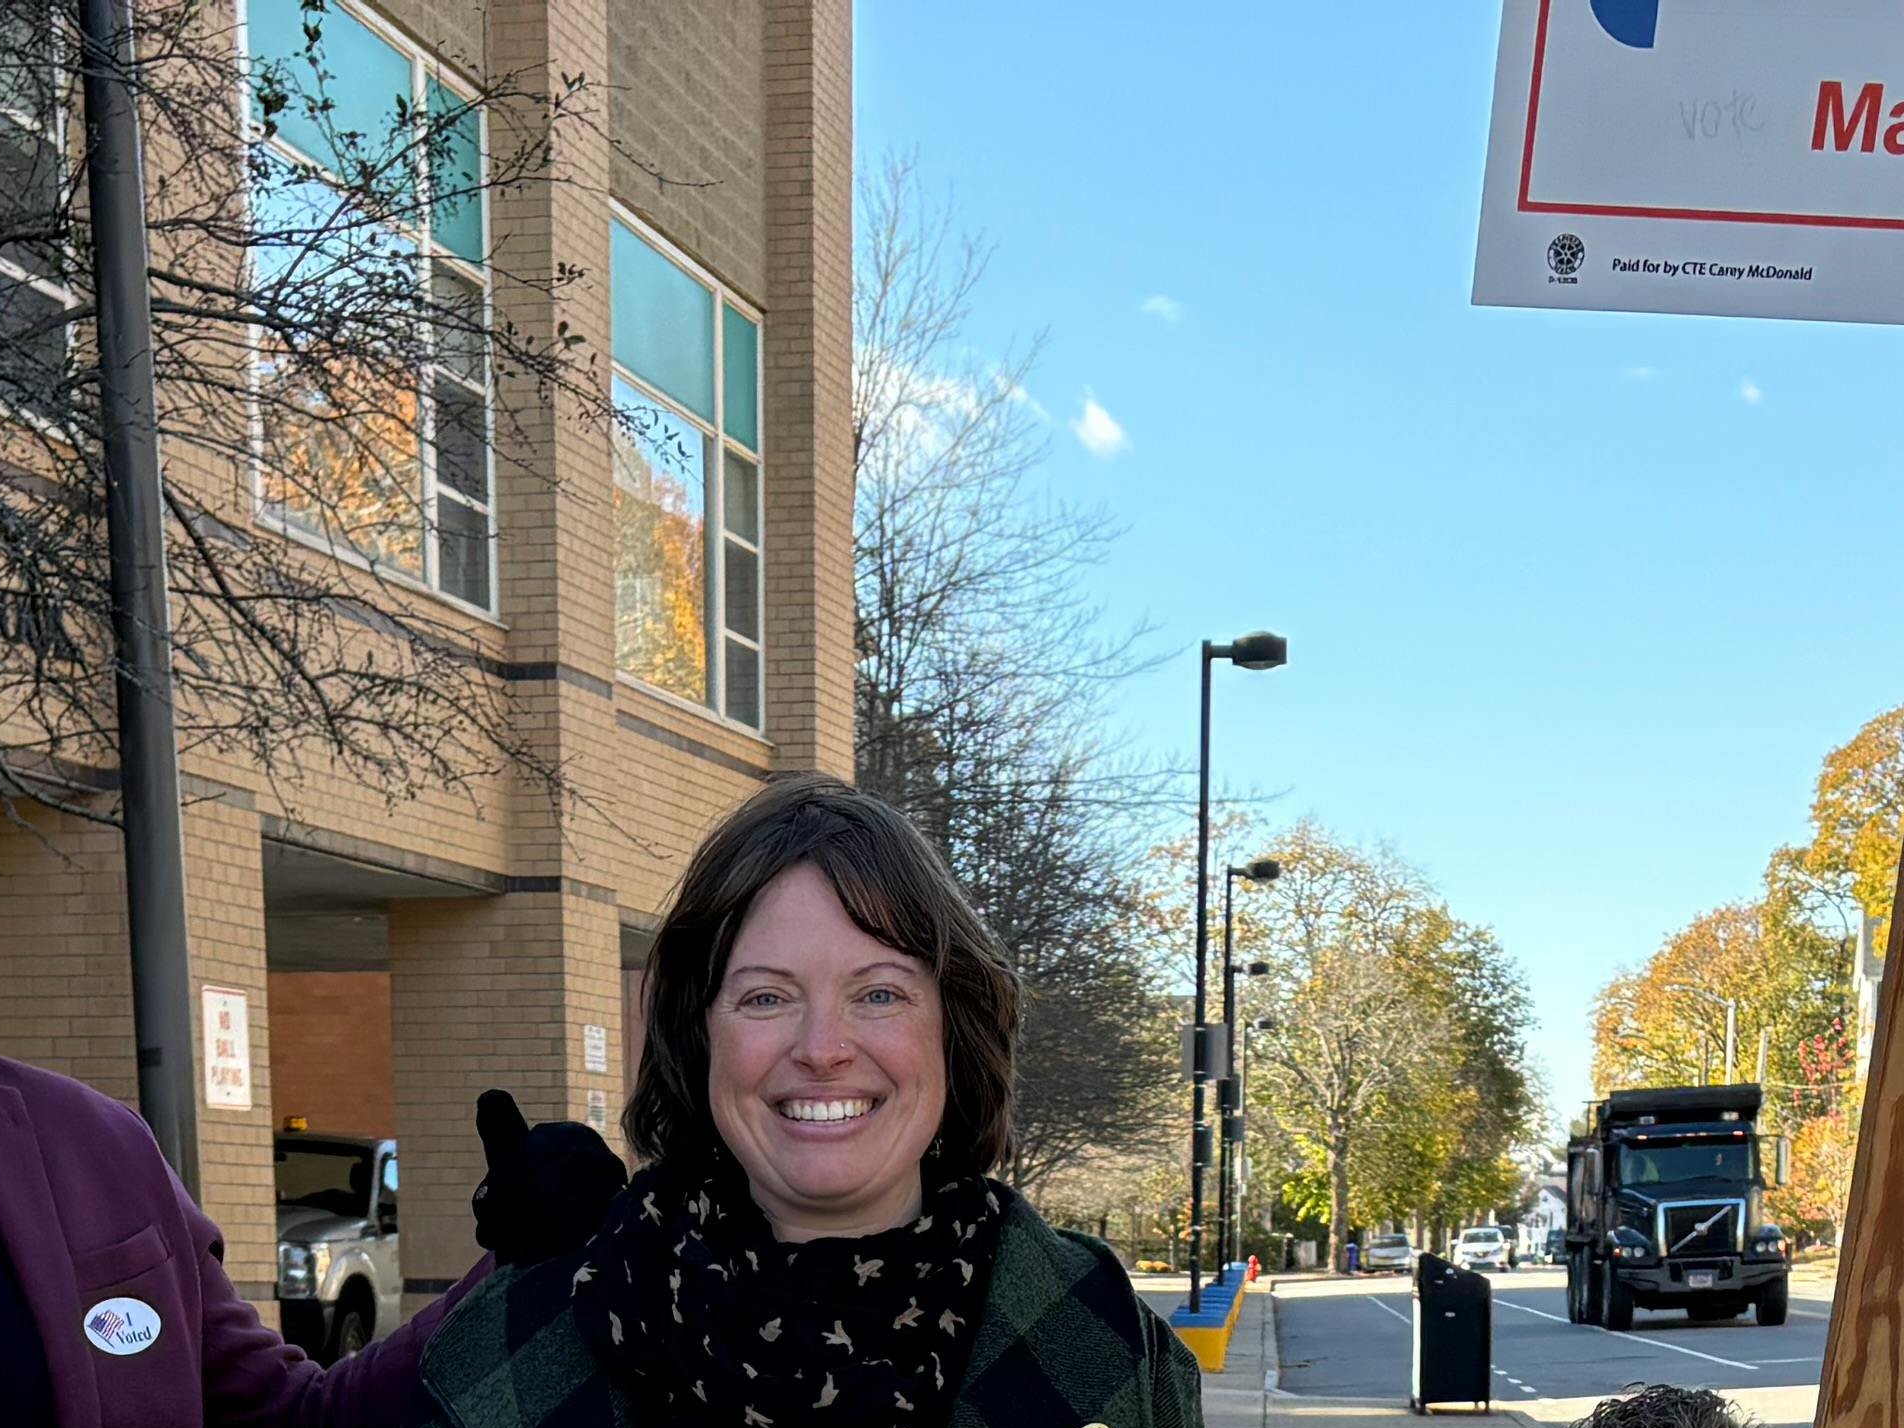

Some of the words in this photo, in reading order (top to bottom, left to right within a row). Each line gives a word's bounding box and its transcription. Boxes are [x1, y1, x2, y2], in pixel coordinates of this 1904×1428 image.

[1612, 258, 1640, 272] Paid
[1642, 259, 1661, 274] for
[1663, 261, 1680, 277] by
[1681, 261, 1707, 276] CTE
[1708, 263, 1746, 281] Carey
[1745, 264, 1813, 281] McDonald
[126, 1311, 132, 1327] I
